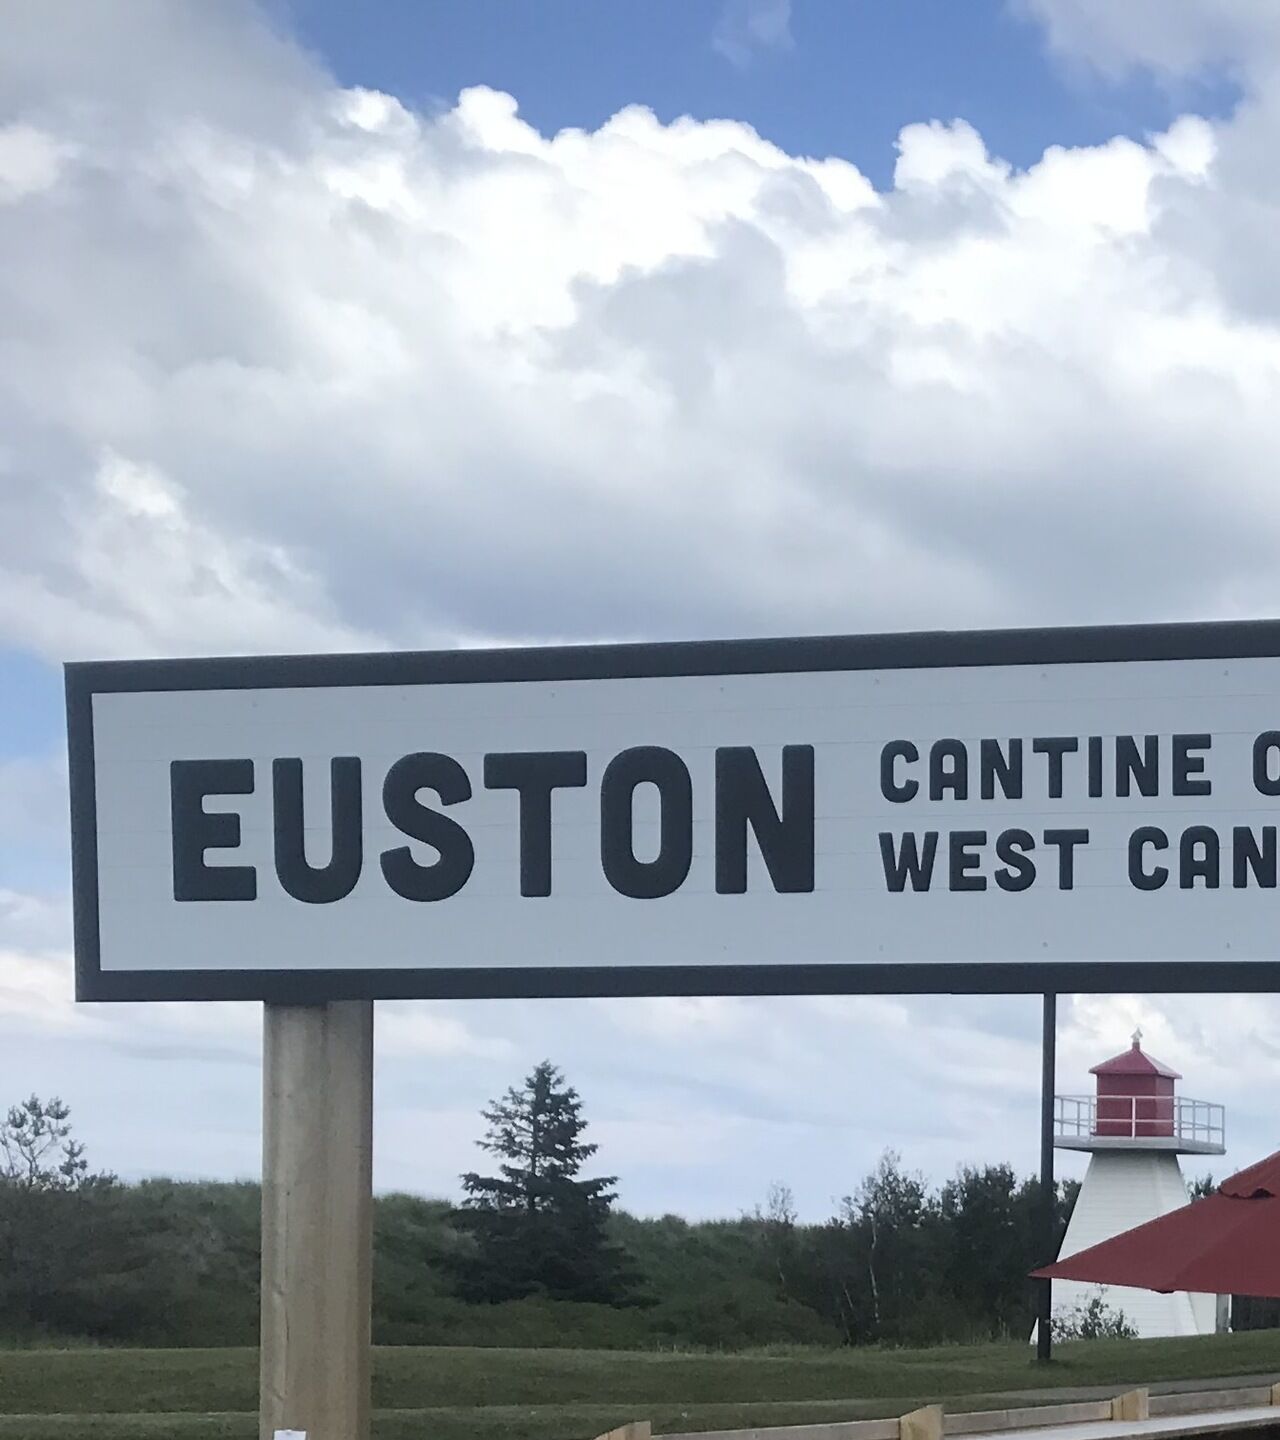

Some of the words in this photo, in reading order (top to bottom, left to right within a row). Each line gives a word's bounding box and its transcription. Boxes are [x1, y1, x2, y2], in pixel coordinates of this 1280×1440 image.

[880, 733, 1212, 803] CANTINE
[170, 744, 815, 904] EUSTON
[879, 828, 1089, 893] WEST
